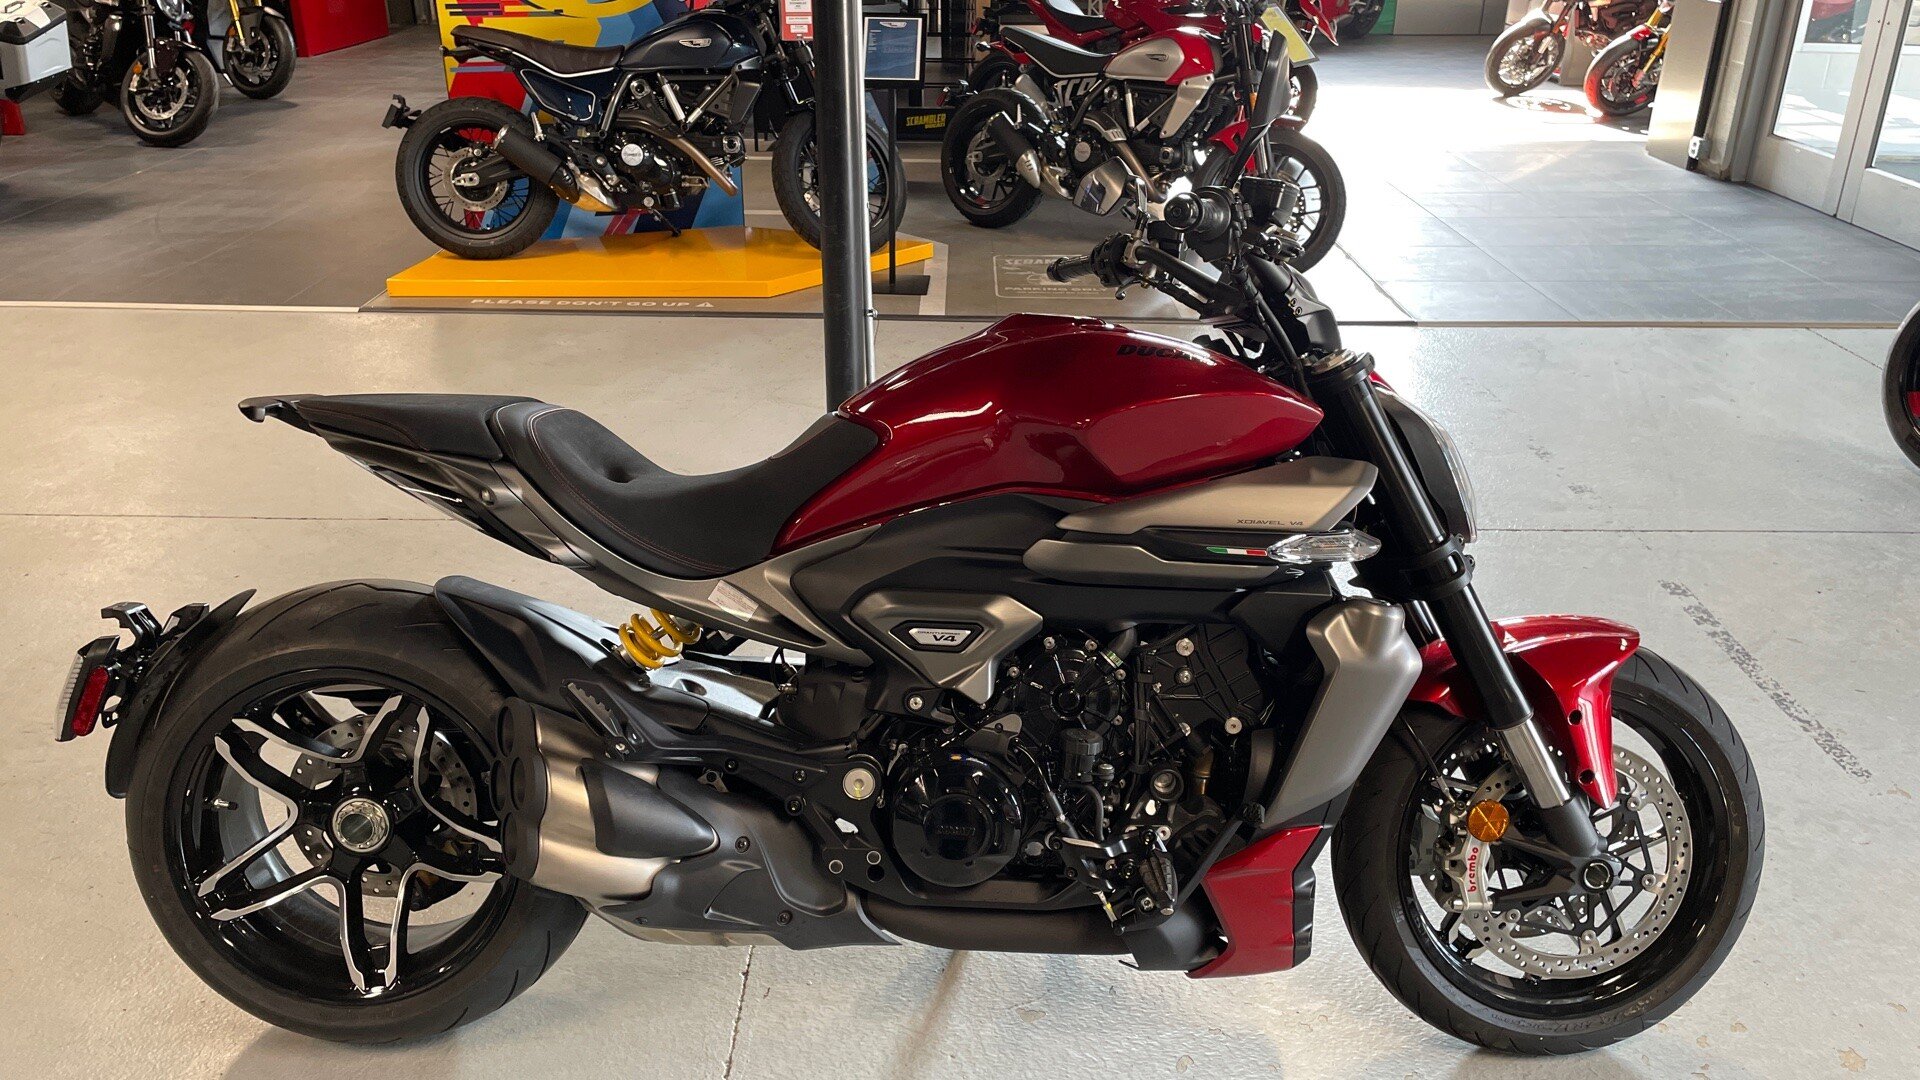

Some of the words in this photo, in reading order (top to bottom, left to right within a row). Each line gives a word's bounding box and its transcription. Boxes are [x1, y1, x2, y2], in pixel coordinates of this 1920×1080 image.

[906, 114, 946, 126] SCRAMBLER
[932, 634, 957, 642] V4
[1467, 847, 1479, 892] brembo
